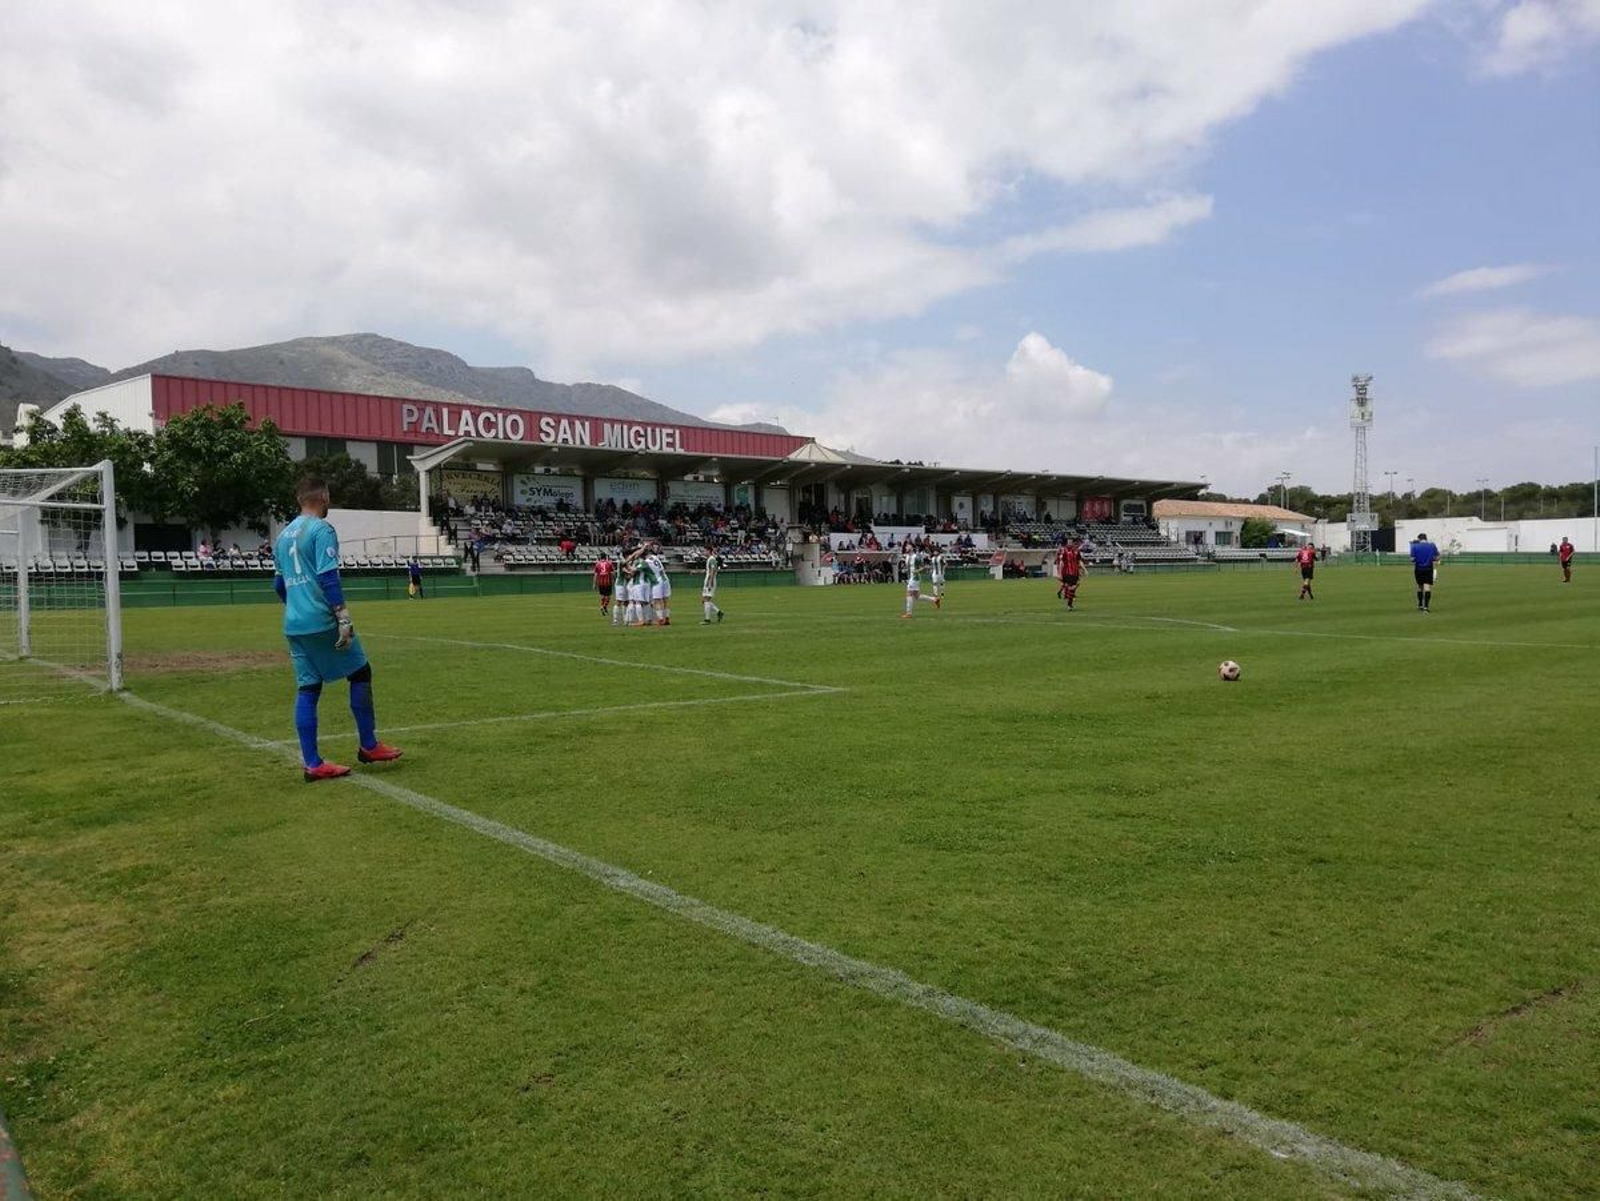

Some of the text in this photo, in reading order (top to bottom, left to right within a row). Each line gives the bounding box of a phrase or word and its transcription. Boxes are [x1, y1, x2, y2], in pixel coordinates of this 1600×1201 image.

[402, 403, 685, 453] PALACIO SAN MIGUEL
[288, 539, 302, 575] 1
